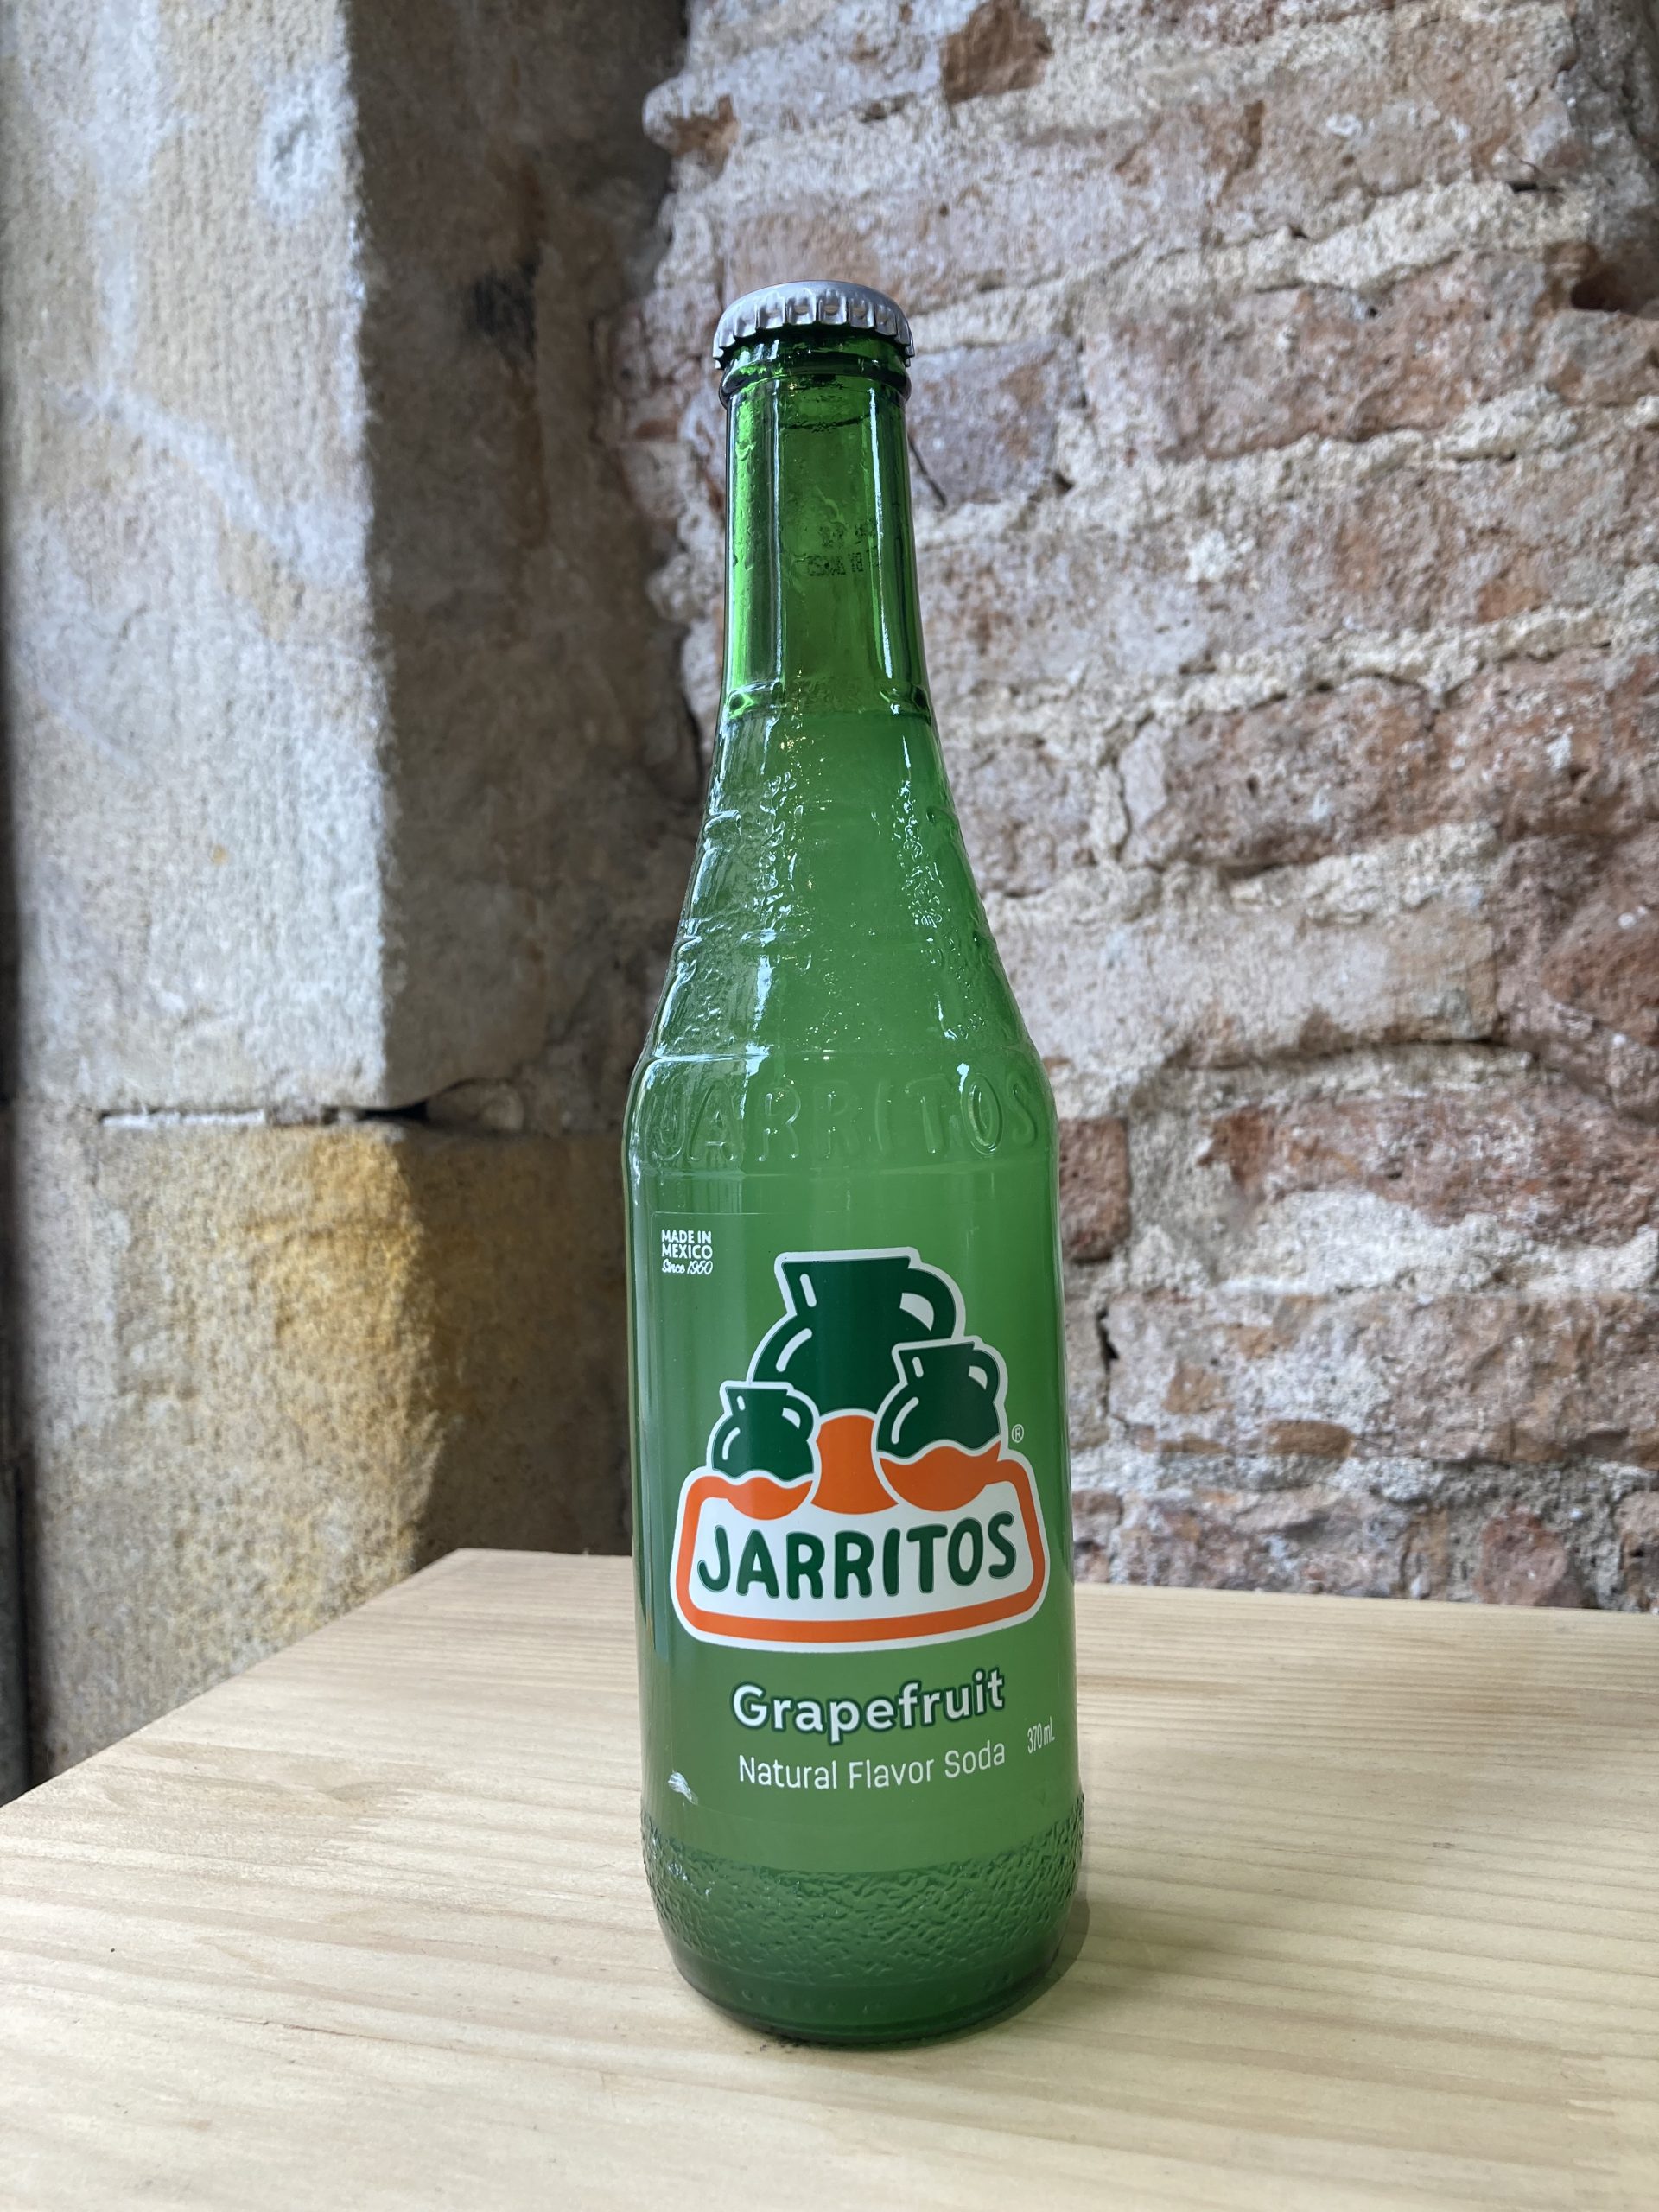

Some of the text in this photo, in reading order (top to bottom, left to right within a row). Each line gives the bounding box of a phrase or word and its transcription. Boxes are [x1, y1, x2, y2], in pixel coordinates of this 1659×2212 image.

[661, 1229, 712, 1244] MADE IN
[661, 1243, 713, 1259] MEXICO
[662, 1258, 714, 1275] Since 1950
[697, 1510, 1017, 1600] JARRITOS
[732, 1668, 1006, 1744] Grapefruit
[739, 1739, 1006, 1790] Natural Flavor Soda
